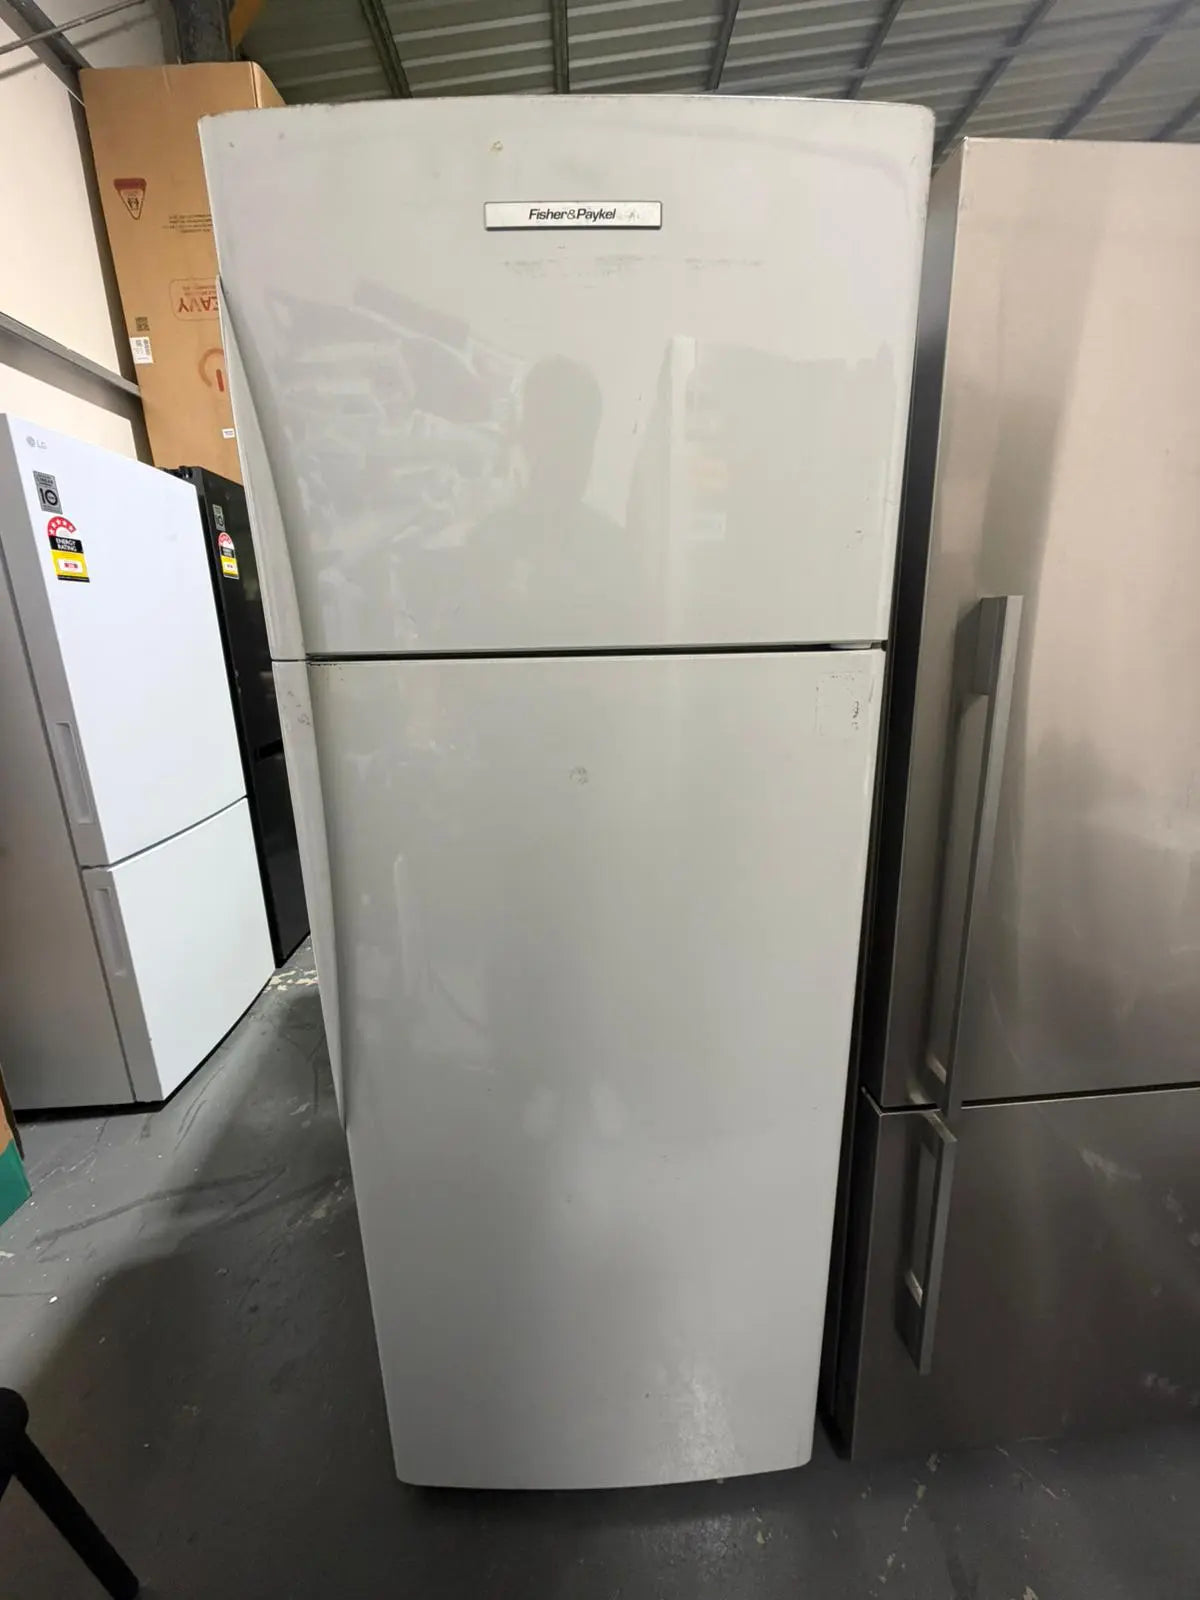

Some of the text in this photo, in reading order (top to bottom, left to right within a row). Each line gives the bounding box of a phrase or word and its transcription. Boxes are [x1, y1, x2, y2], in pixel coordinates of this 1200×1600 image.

[528, 208, 616, 222] Fisher&Paykel
[179, 296, 218, 312] EAVY
[56, 538, 76, 547] ENERGY
